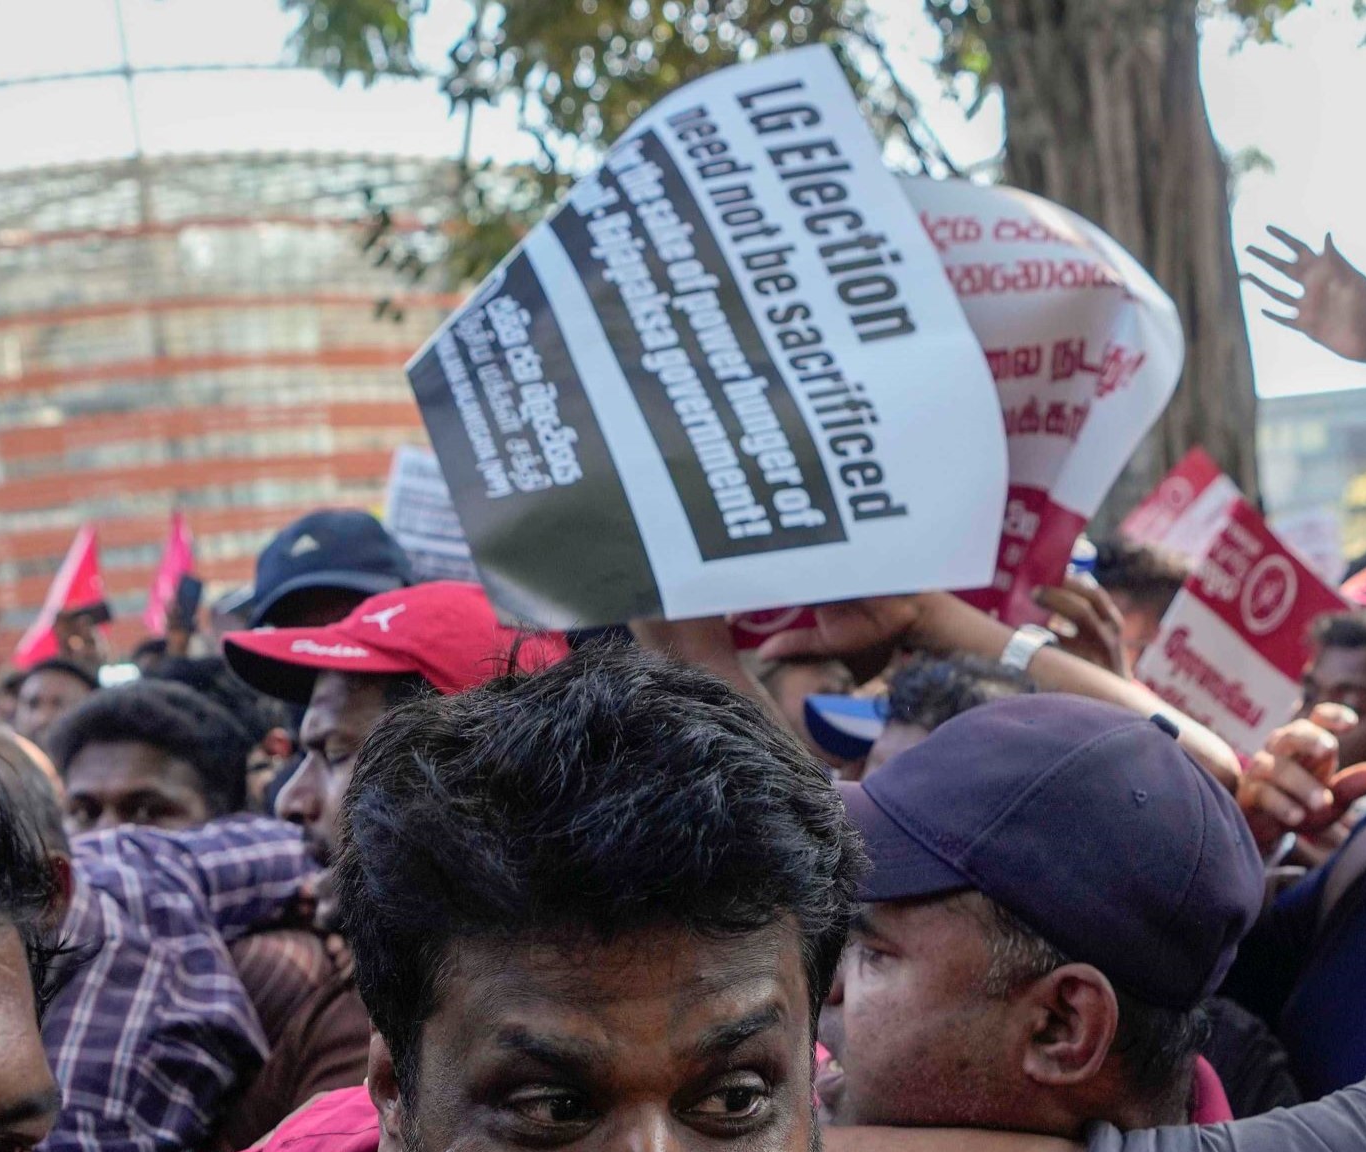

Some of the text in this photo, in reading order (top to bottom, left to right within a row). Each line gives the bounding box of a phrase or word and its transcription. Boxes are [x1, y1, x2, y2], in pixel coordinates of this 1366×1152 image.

[636, 198, 695, 263] sake
[736, 80, 917, 344] LG Election
[666, 258, 721, 294] of
[667, 105, 910, 521] need not be sacrificed
[585, 210, 678, 351] Rajapaksa
[643, 344, 773, 540] government!
[672, 288, 753, 380] power
[722, 375, 805, 485] hunger
[771, 486, 827, 530] of
